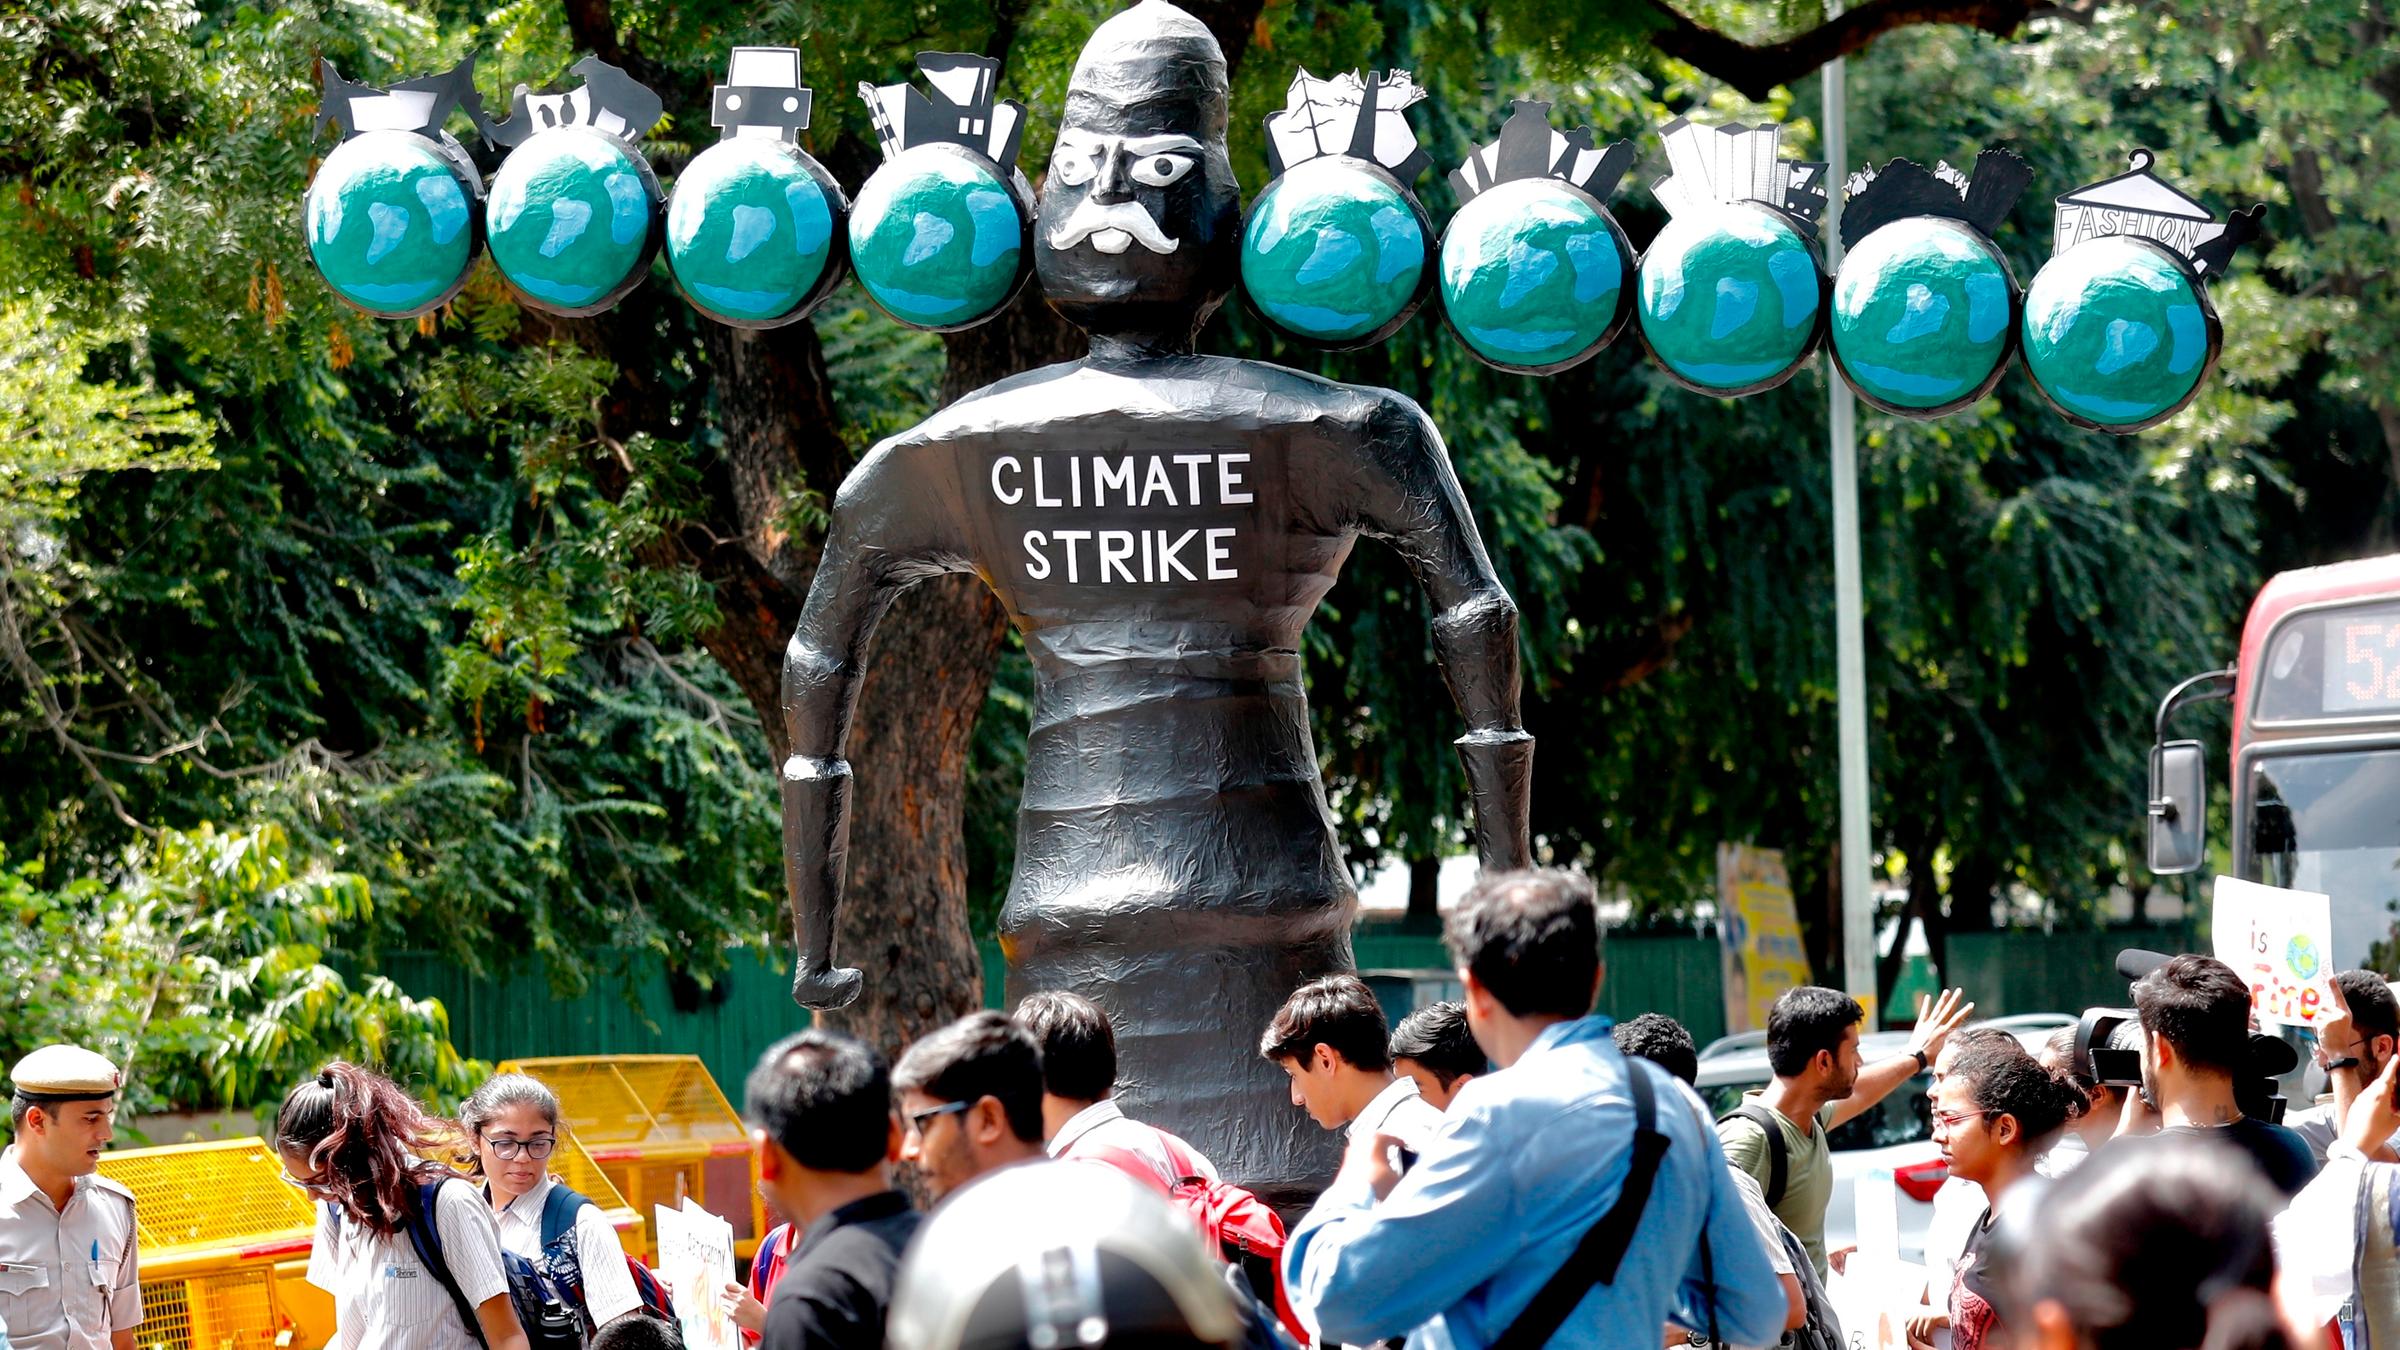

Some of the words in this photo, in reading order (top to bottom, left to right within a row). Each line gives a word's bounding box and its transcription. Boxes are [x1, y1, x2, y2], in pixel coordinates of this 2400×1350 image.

[2051, 205, 2203, 257] FASHION
[991, 453, 1253, 507] CLIMATE
[1023, 528, 1238, 583] STRIKE
[2251, 919, 2268, 954] is
